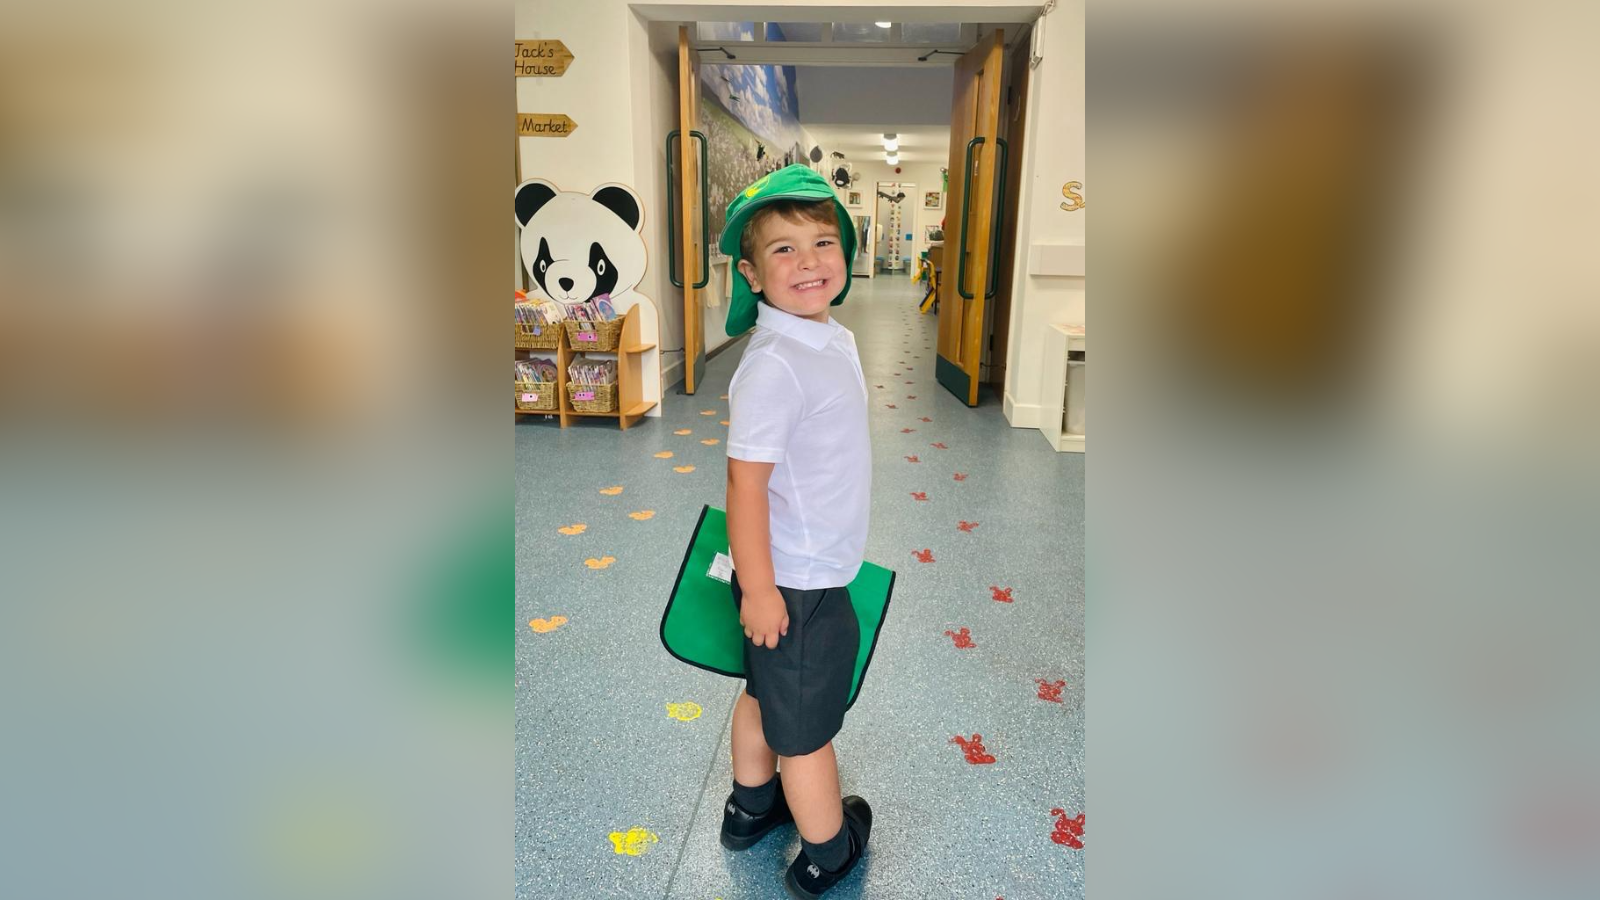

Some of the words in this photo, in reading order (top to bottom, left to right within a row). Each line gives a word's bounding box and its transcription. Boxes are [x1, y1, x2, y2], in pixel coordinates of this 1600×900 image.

[515, 42, 554, 58] Jack's
[515, 60, 556, 75] House
[521, 118, 568, 133] Market
[1060, 181, 1085, 212] S
